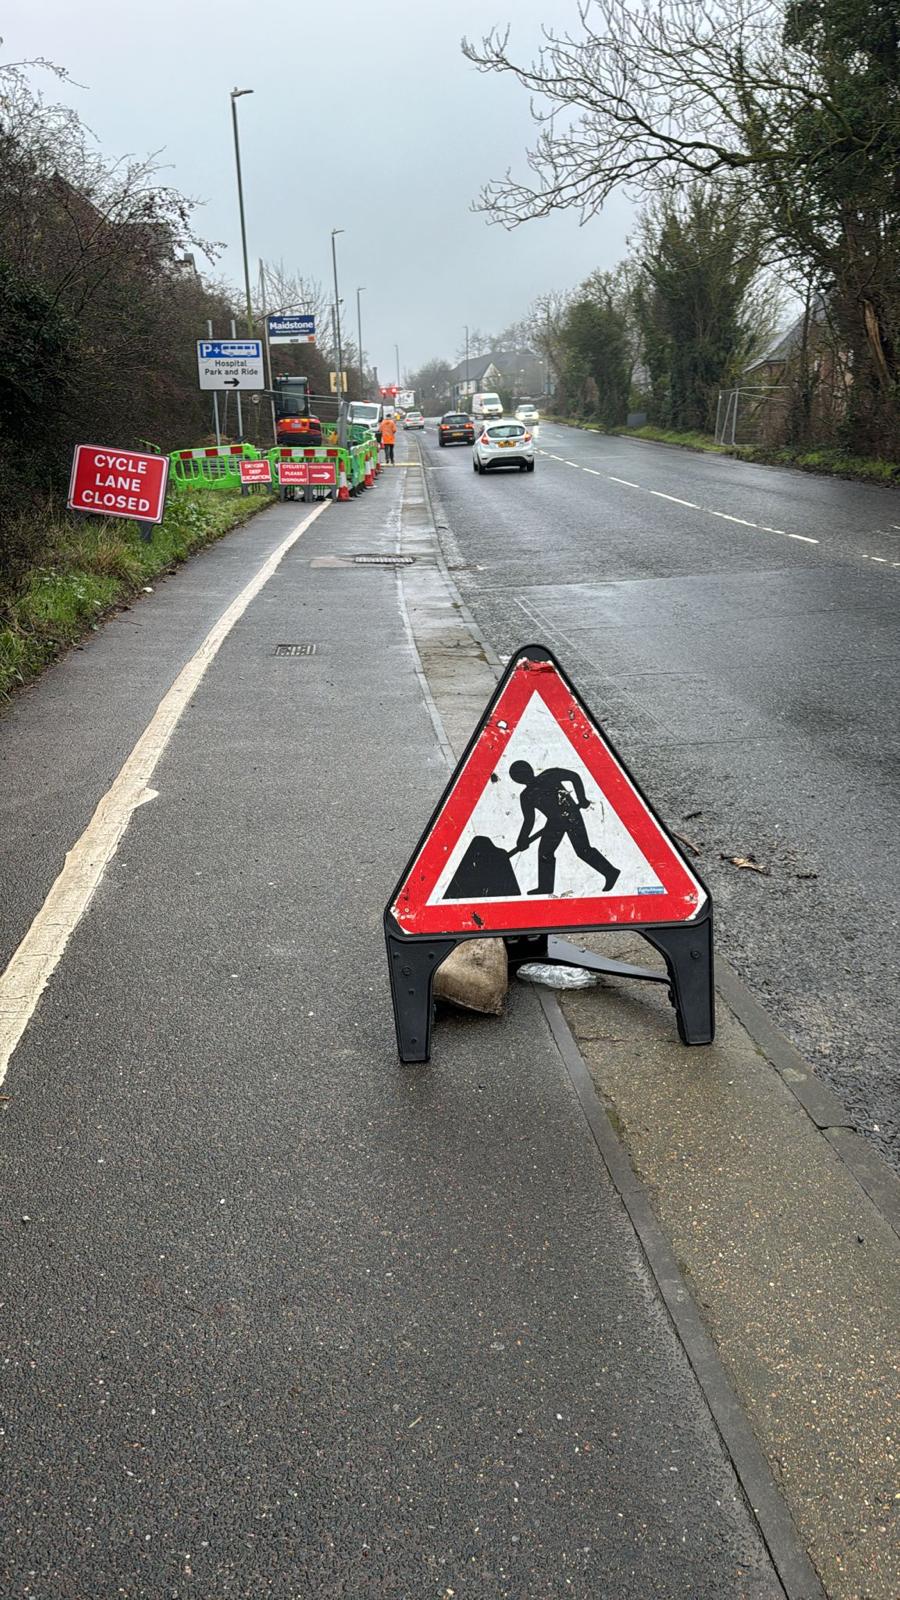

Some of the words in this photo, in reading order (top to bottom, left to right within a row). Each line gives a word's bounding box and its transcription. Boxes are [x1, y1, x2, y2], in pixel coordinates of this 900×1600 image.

[270, 321, 313, 330] Maidstone
[215, 360, 247, 368] Hospital
[94, 454, 148, 474] CYCLE
[95, 473, 141, 492] LANE
[81, 489, 150, 512] CLOSED
